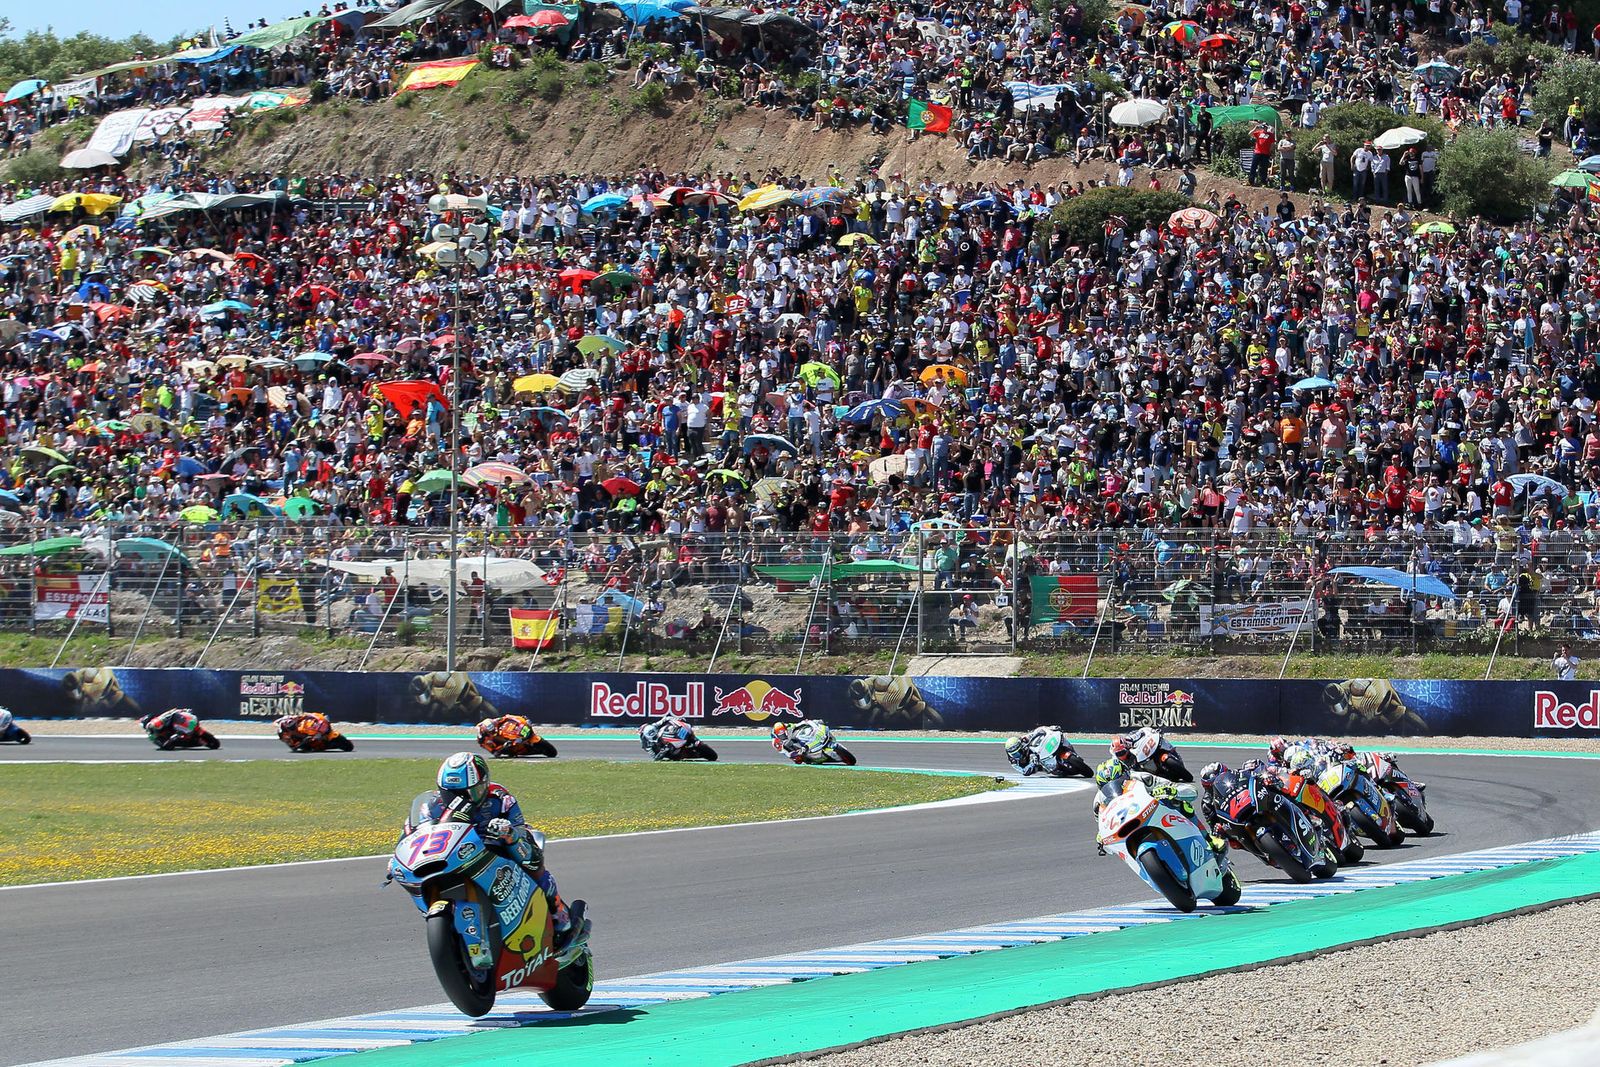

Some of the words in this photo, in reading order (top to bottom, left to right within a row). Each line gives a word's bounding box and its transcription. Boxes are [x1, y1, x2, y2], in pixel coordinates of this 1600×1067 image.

[1231, 617, 1270, 628] ESTAMOS
[1272, 615, 1308, 626] CONTIO
[591, 682, 647, 717] Red
[648, 682, 705, 718] Bull
[1119, 683, 1140, 692] GRAN
[1142, 683, 1170, 693] PREMIO
[1119, 691, 1141, 705] Red
[1141, 691, 1163, 705] Bull
[1534, 690, 1600, 729] Red
[405, 831, 453, 867] 73
[499, 898, 523, 926] BEER
[501, 946, 553, 992] TOTAL
